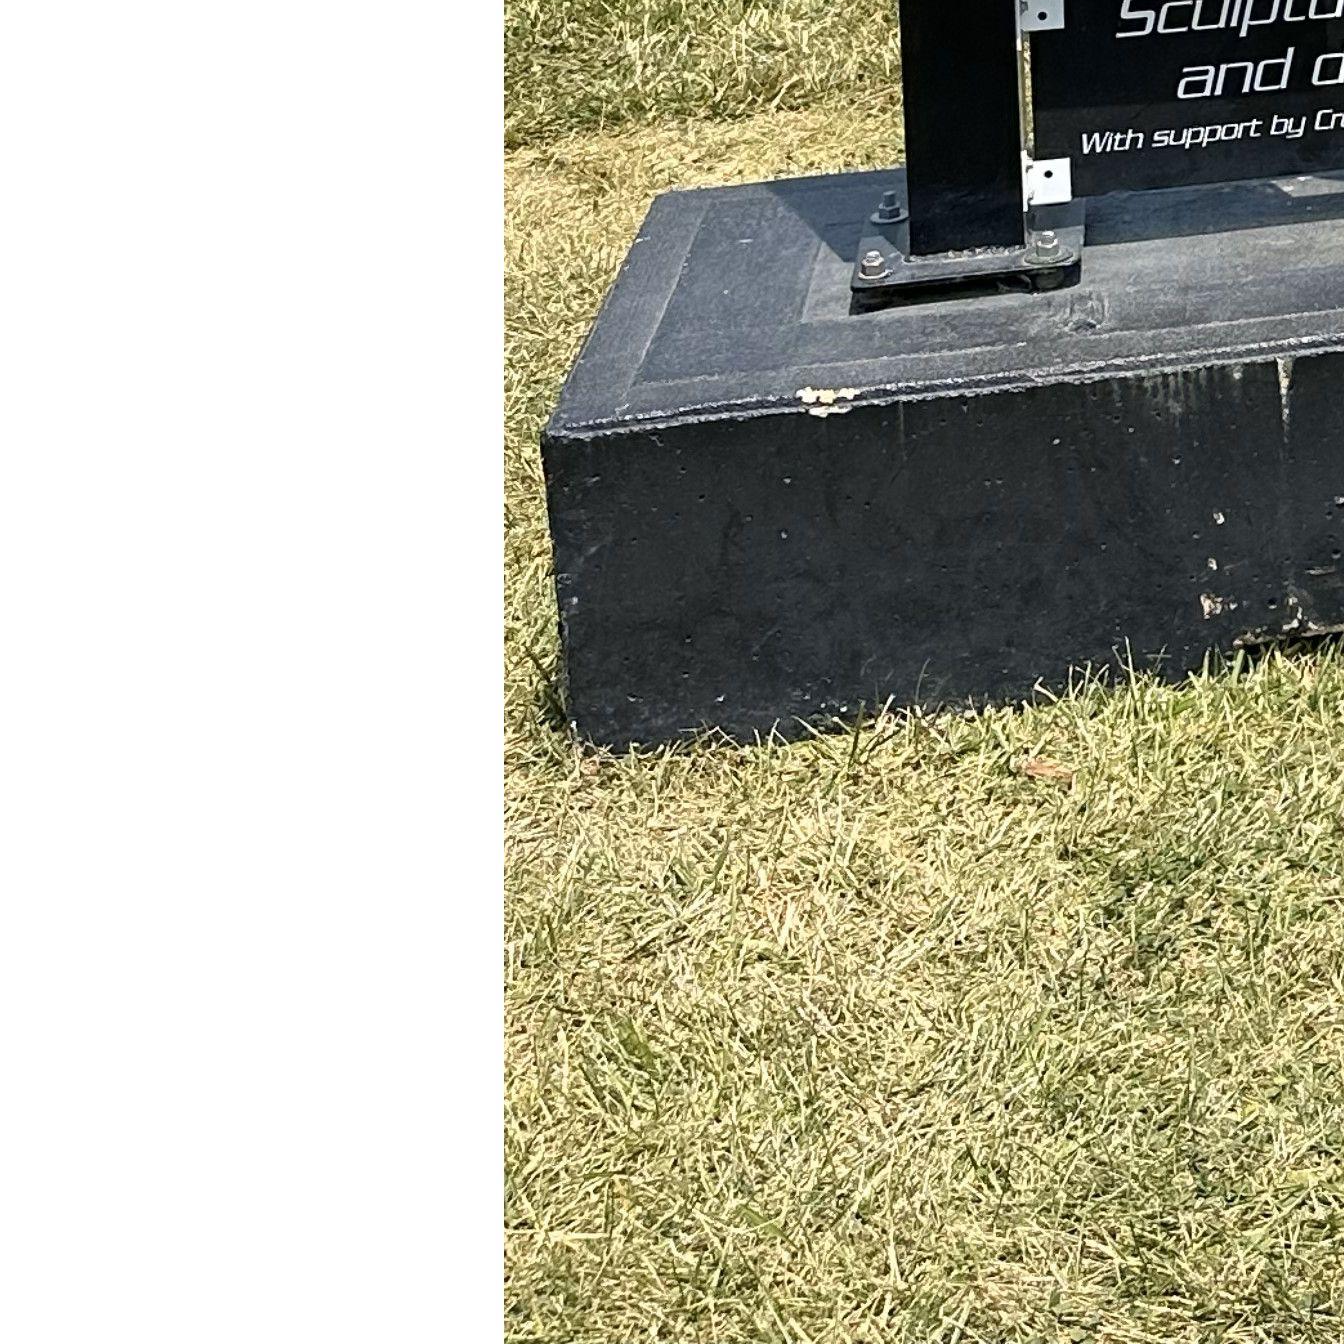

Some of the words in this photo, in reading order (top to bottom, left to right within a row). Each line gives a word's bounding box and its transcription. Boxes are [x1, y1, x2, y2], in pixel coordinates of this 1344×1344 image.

[1177, 48, 1295, 99] and
[1081, 129, 1144, 155] With
[1150, 118, 1263, 149] support
[1269, 114, 1306, 140] by
